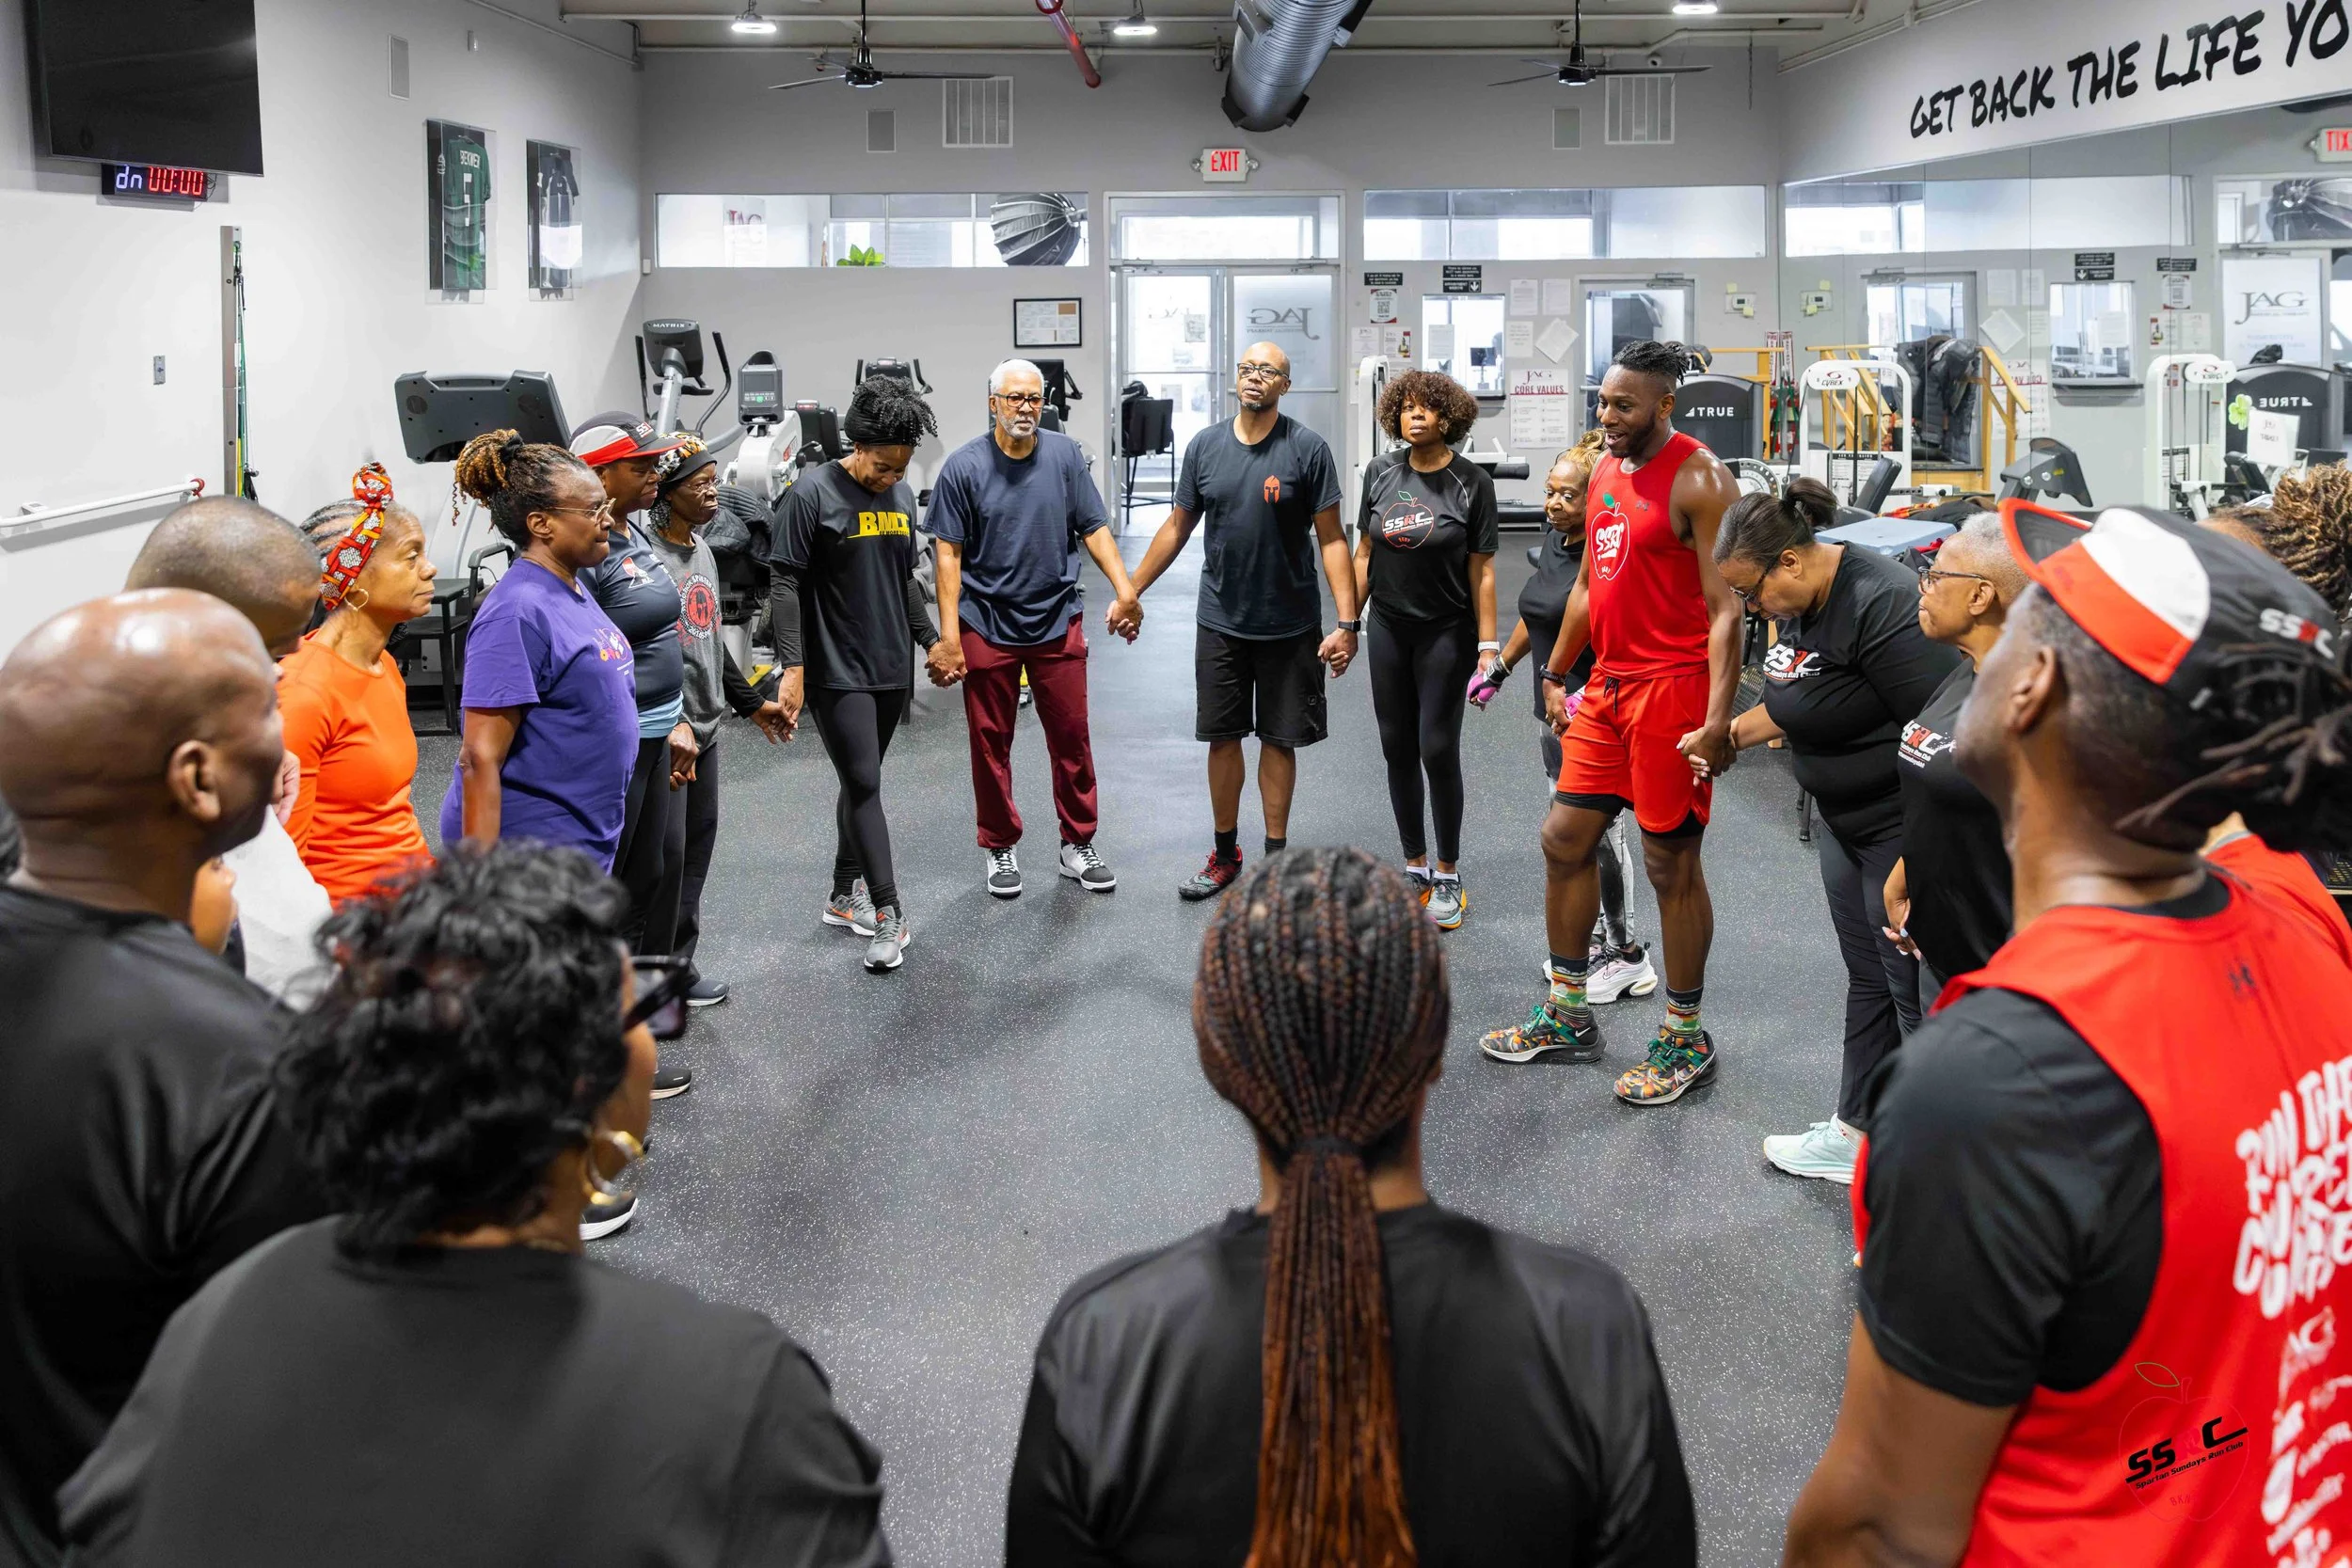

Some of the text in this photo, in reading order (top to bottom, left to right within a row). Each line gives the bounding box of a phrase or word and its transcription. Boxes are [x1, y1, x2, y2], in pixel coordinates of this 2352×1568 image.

[1911, 85, 1963, 138] GET
[1968, 66, 2055, 129] BACK
[2067, 40, 2140, 109] THE
[2155, 9, 2265, 91] LIFE
[1211, 150, 1240, 172] EXIT
[2234, 291, 2309, 325] JAG
[1515, 385, 1564, 394] CORE VALUES
[1697, 406, 1734, 418] TRUE
[1383, 512, 1434, 532] SSRC
